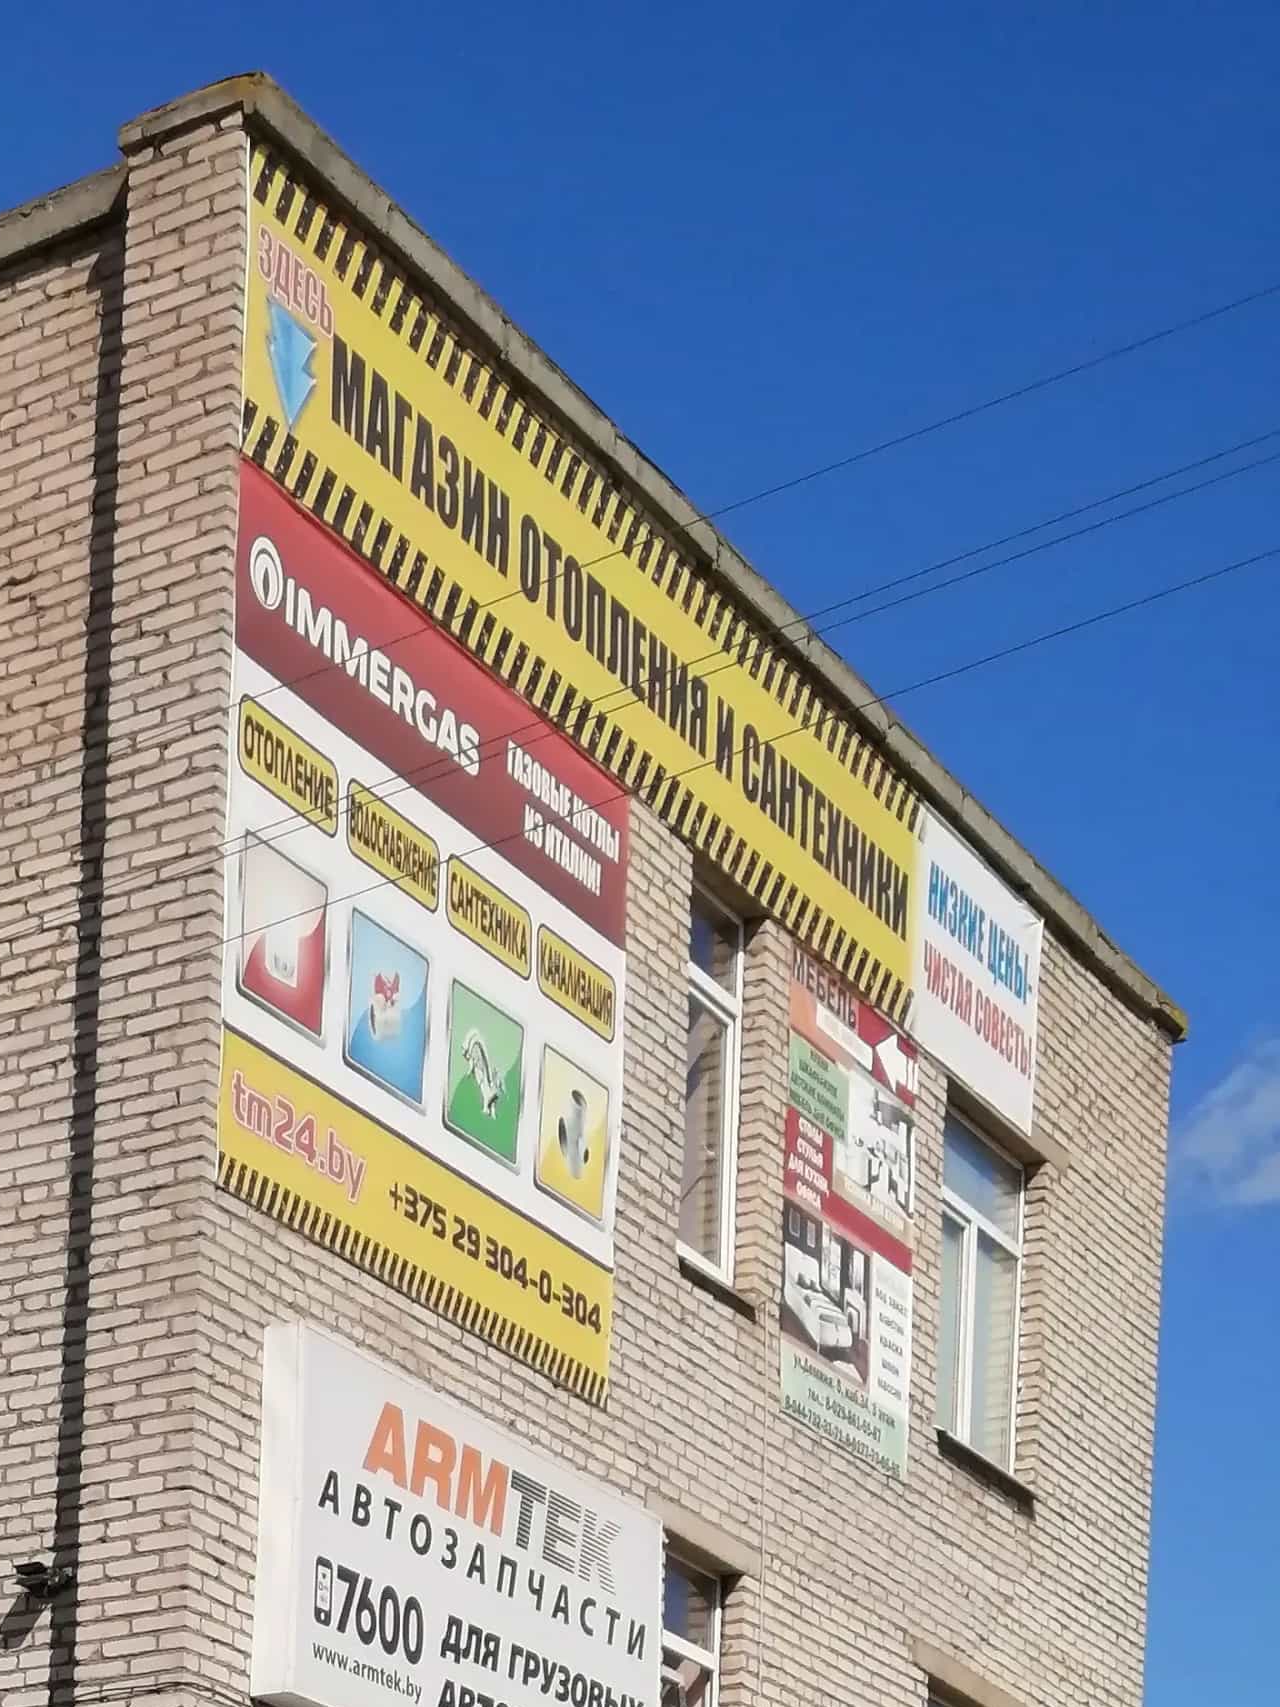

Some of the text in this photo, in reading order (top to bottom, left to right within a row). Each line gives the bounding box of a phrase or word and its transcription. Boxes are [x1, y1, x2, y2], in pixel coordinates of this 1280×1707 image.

[257, 224, 334, 337] ЗДЕСЬ
[285, 575, 481, 778] IMMERGAS
[331, 338, 908, 943] МАГАЗИН ОТОПЛЕНИЯ И САНТЕХНИКИ
[243, 713, 336, 820] ОТОПЛЕНИЕ
[506, 738, 621, 864] ГАЗОВЫЕ КОТЛЫ
[349, 795, 438, 898] ВОДОСНАБЖЕНИЕ
[524, 804, 602, 897] ИЗ ИТАЛИИ!
[449, 871, 530, 966] САНТЕХНИКА
[928, 860, 985, 965] НИЗКИЕ
[539, 938, 614, 1029] КАНАЛИЗАЦИЯ
[924, 939, 1033, 1080] ЧИСТАЯ СОВЕСТЬ!
[230, 1068, 367, 1205] tm24.by
[388, 1179, 602, 1335] +375 29 304-0-304
[363, 1401, 622, 1596] ARMTEK
[317, 1469, 647, 1662] АВТОЗАПЧАСТИ
[336, 1563, 425, 1666] 7600
[312, 1640, 423, 1706] www.armtek.by
[439, 1613, 500, 1674] ДЛЯ
